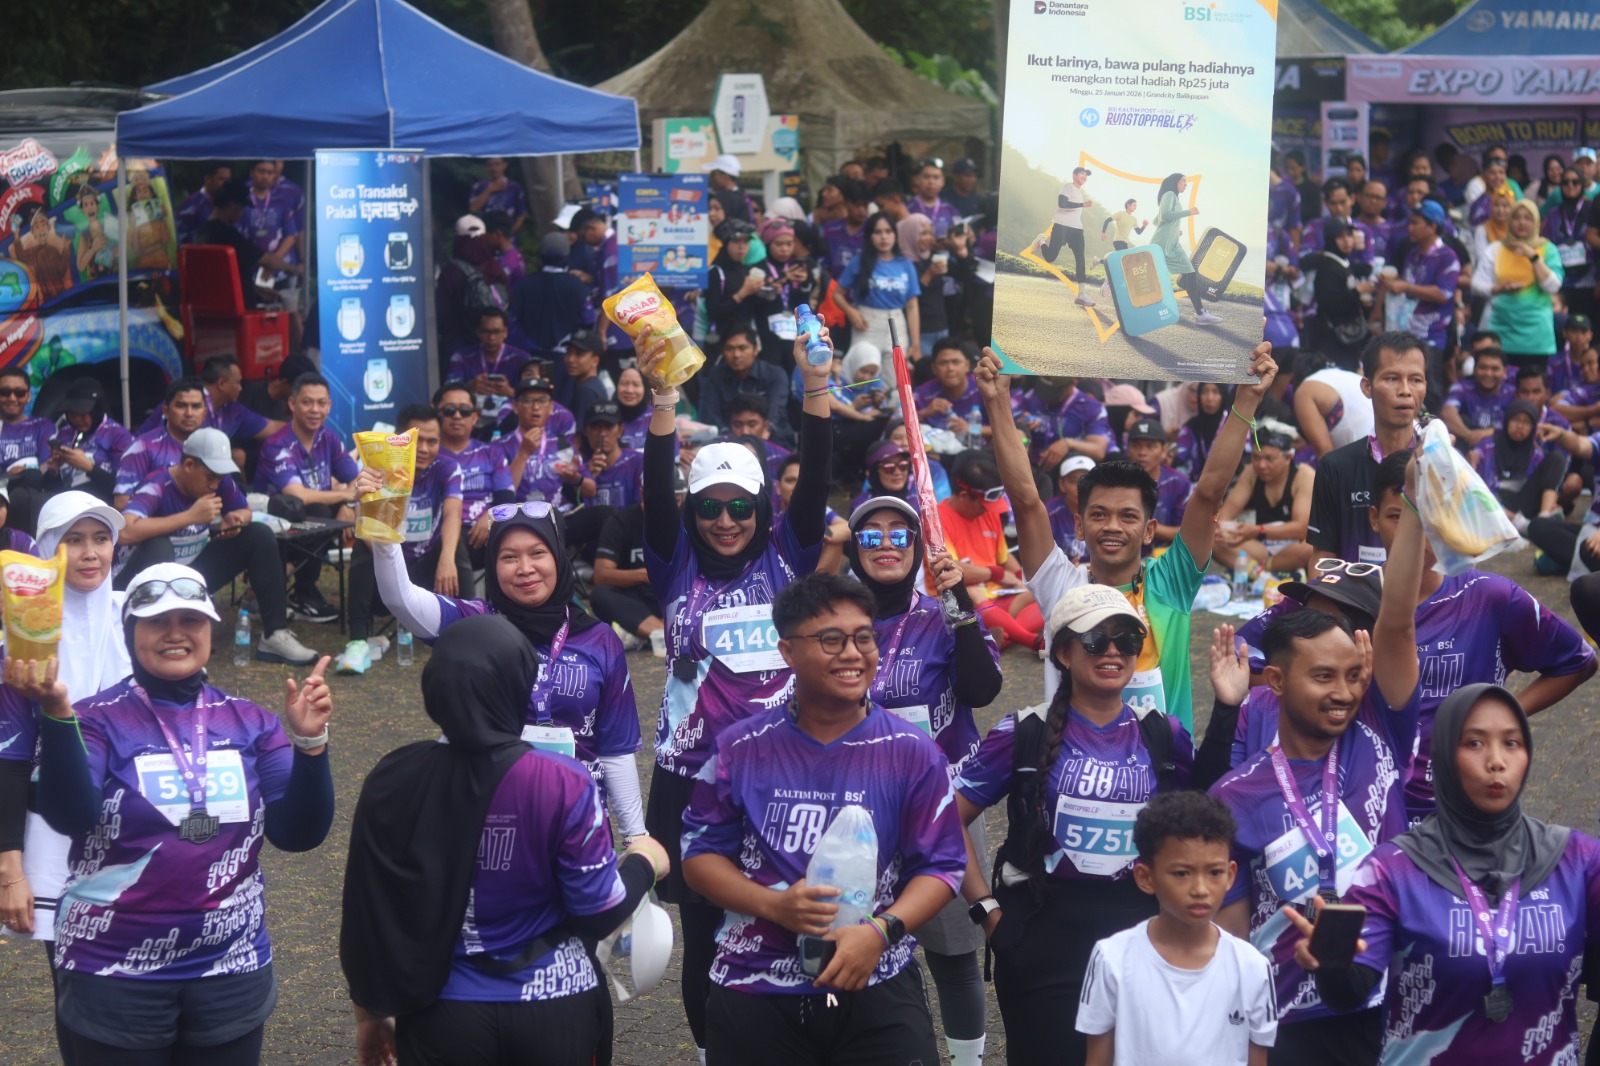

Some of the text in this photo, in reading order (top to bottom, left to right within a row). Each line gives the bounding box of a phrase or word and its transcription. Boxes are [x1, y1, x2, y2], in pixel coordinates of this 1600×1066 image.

[1049, 1, 1089, 9] Danantara
[1501, 11, 1600, 32] YAMAHA
[1027, 54, 1255, 77] Ikut larinya, bawa pulang hadiahnya
[1051, 74, 1229, 91] menangkan total hadiah Rp25 juta
[1408, 68, 1503, 96] EXPO
[1069, 88, 1094, 97] Minggu,
[1104, 89, 1126, 97] Januari
[1127, 90, 1143, 98] 2026
[1147, 91, 1175, 100] Grandcity
[1176, 92, 1209, 101] Balikpapan
[1105, 112, 1184, 129] RUNSTOPPABLE
[1451, 120, 1576, 145] BORN TO RUN
[330, 184, 408, 199] Cara Transaksi
[326, 204, 358, 219] Pakai
[715, 626, 780, 652] 4140
[774, 788, 811, 800] KALTIM
[813, 791, 837, 802] POST
[1064, 822, 1133, 854] 5751
[1283, 832, 1359, 893] 448
[1529, 888, 1549, 901] BSI
